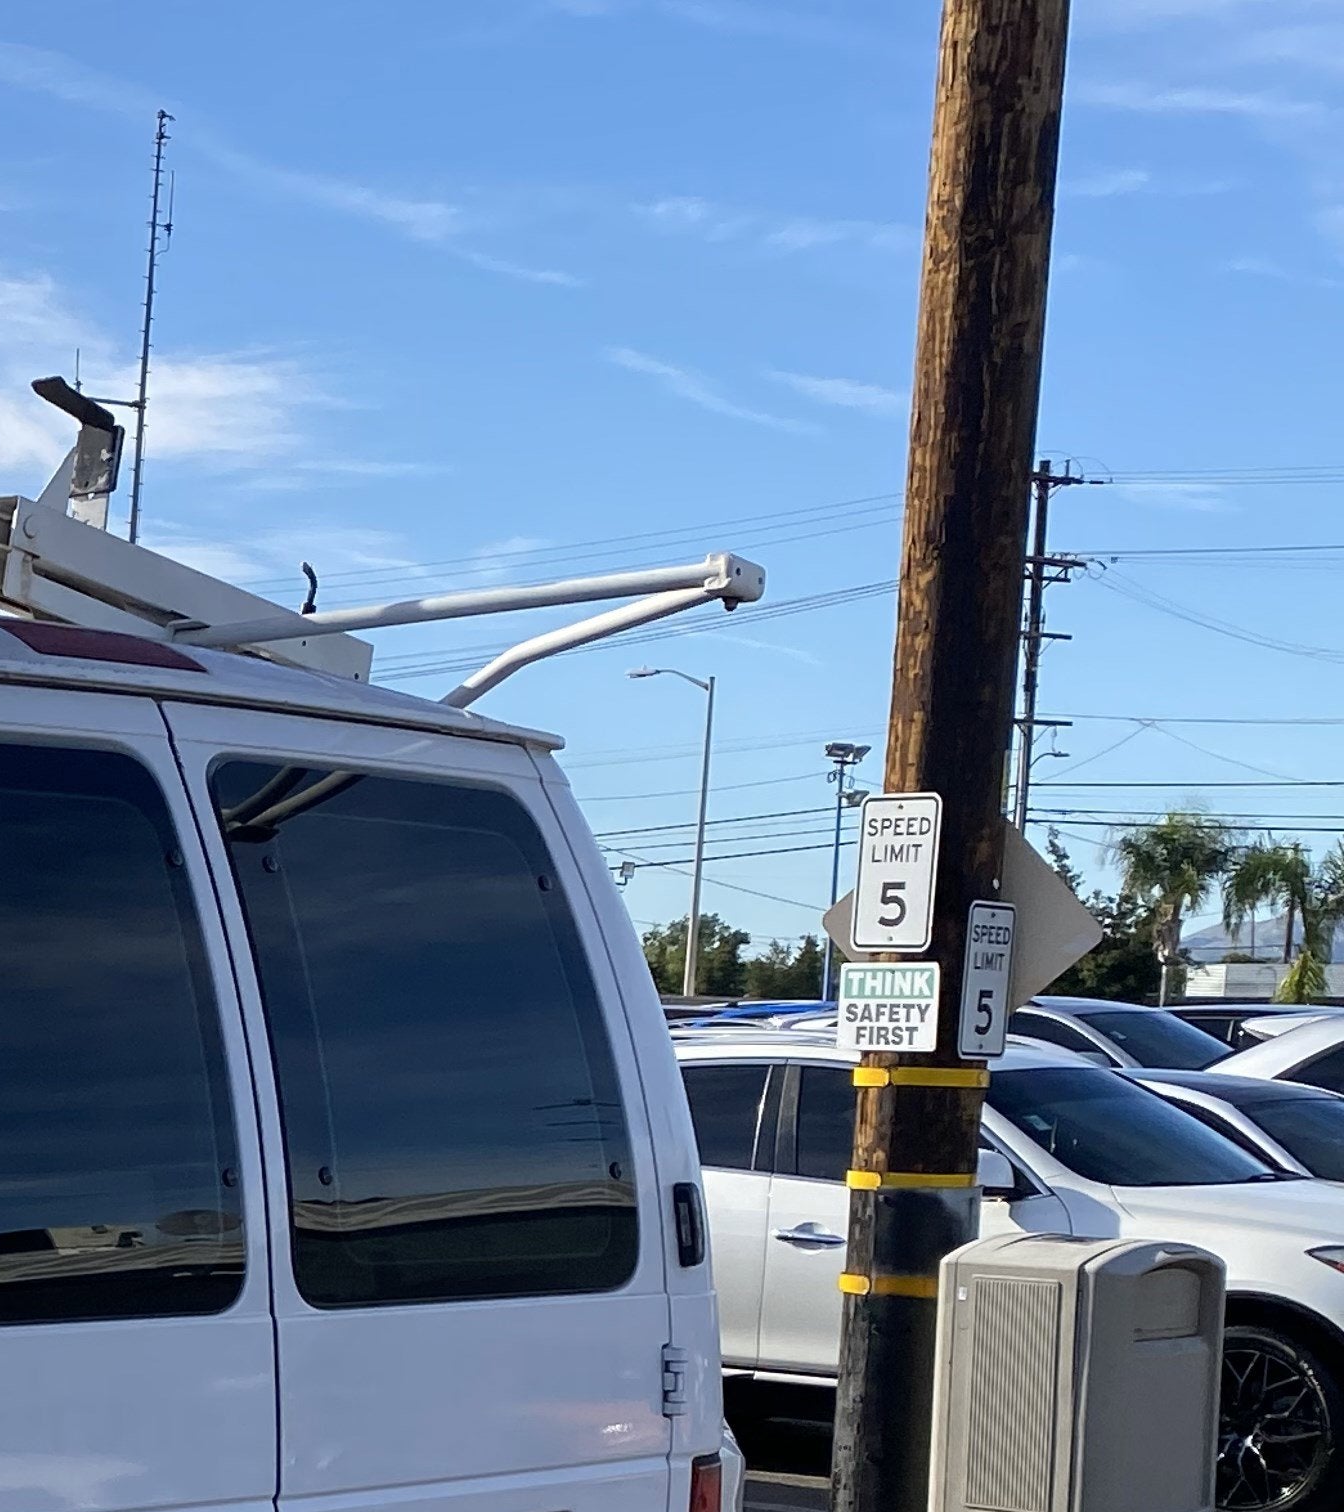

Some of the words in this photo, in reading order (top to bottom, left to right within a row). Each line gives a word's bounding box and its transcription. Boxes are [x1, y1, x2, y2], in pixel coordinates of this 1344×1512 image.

[867, 817, 931, 837] SPEED
[871, 843, 922, 863] LIMIT
[878, 881, 906, 927] 5
[972, 924, 1011, 945] SPEED
[973, 953, 1005, 970] LIMIT
[848, 972, 932, 997] THINK
[845, 1003, 931, 1023] SAFETY
[975, 989, 994, 1036] 5
[855, 1026, 918, 1046] FIRST
